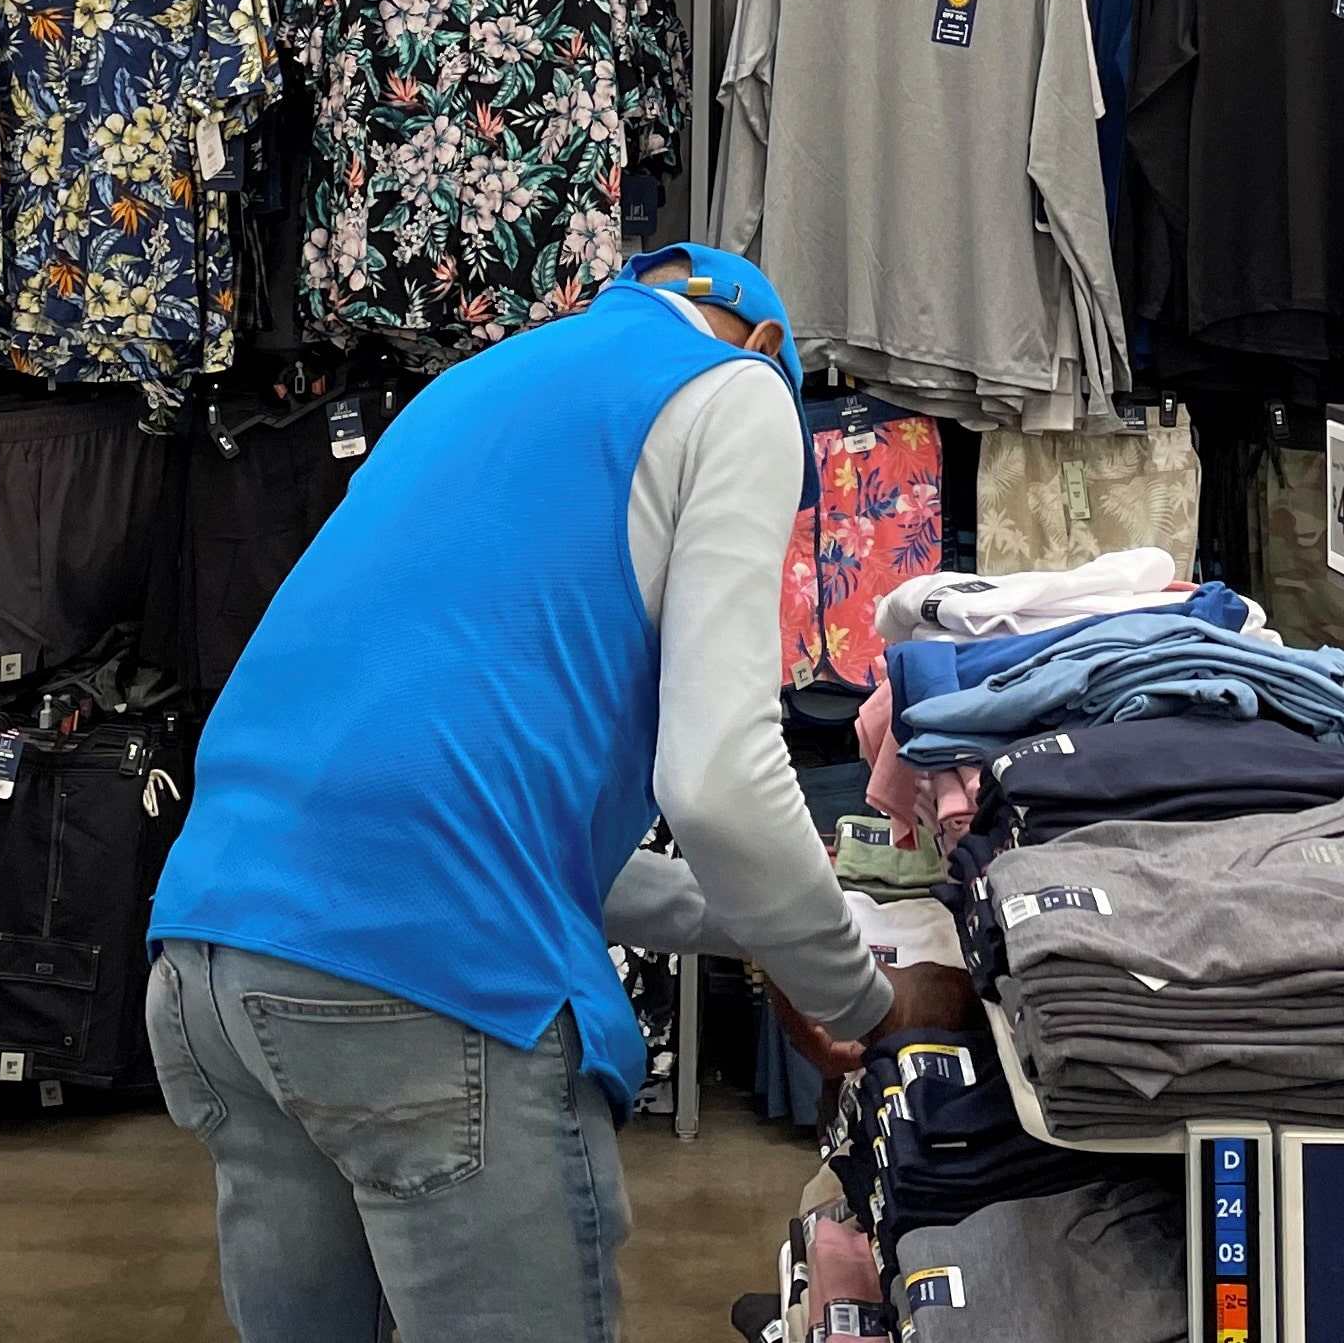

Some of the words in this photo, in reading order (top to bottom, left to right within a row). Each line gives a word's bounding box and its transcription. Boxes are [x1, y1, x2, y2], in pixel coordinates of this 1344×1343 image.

[1224, 1150, 1241, 1170] D
[1216, 1198, 1244, 1218] 24
[1218, 1243, 1245, 1263] 03
[1225, 1294, 1237, 1310] 24
